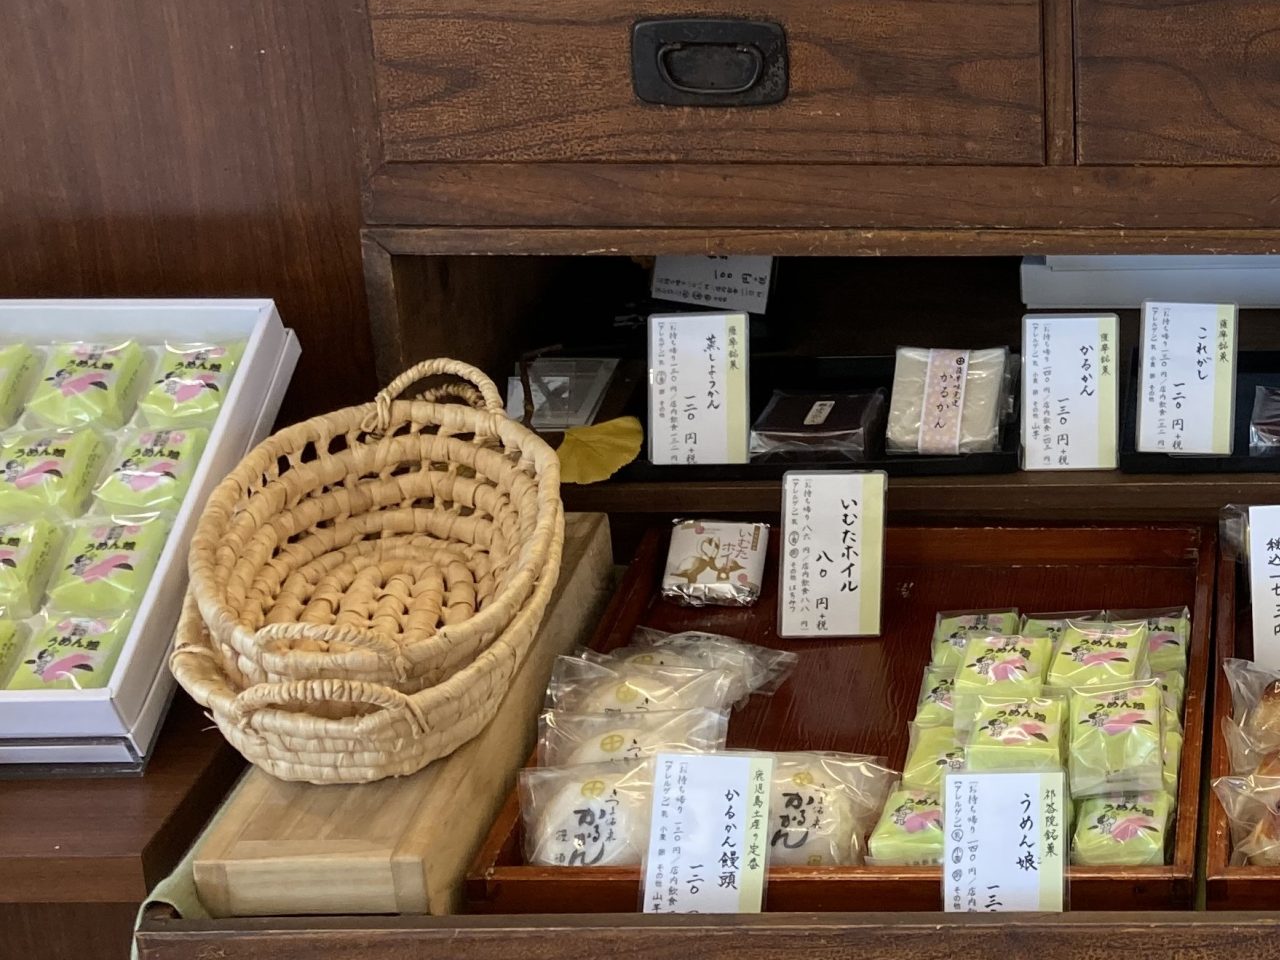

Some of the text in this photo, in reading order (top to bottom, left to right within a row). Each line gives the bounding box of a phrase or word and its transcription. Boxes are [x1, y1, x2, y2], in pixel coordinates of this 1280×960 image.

[1100, 332, 1111, 377] 薩摩銘菓
[1196, 327, 1212, 381] これがし
[1218, 319, 1229, 363] 薩摩銘菓
[934, 371, 953, 430] かるかん
[1079, 344, 1095, 398] かるかん
[840, 498, 859, 592] いむたホイル
[718, 788, 741, 891] かるかん饅頭
[1016, 794, 1038, 871] うめん娘
[1044, 789, 1059, 858] 祁答院銘菓
